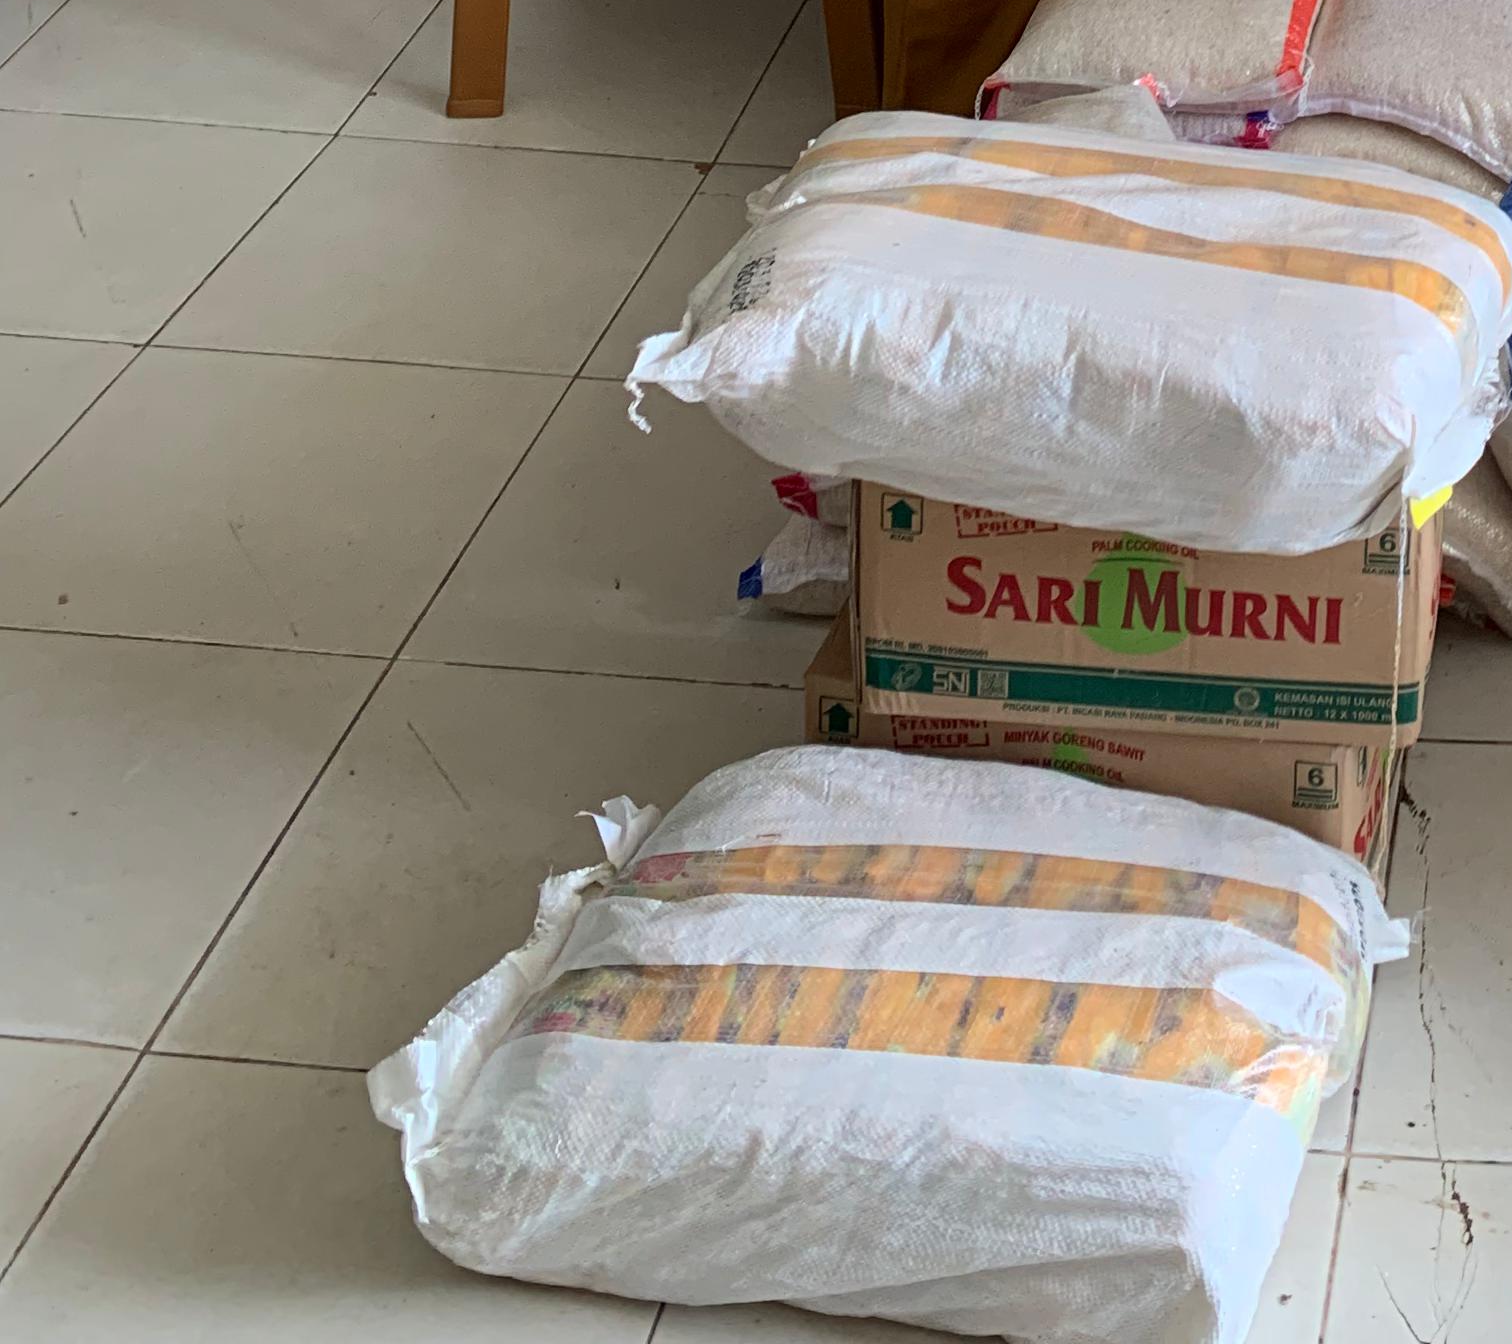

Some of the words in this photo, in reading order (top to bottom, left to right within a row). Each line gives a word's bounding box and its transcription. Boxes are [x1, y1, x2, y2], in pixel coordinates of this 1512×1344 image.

[1092, 540, 1123, 554] PALM
[1126, 539, 1178, 555] COOKING
[1180, 546, 1199, 560] OIL
[1379, 534, 1396, 552] 6
[1362, 568, 1411, 576] MAXIMM
[945, 556, 1102, 627] SARI
[1121, 568, 1343, 644] MURNI
[1274, 692, 1334, 706] KEMASAN
[1274, 706, 1313, 718] NETTO
[912, 732, 969, 746] POUCH
[1004, 730, 1050, 745] MINYAK
[1052, 732, 1105, 752] GORENG
[1108, 742, 1146, 762] SAWIT
[1055, 759, 1105, 779] COOKING
[1307, 768, 1324, 786] 6
